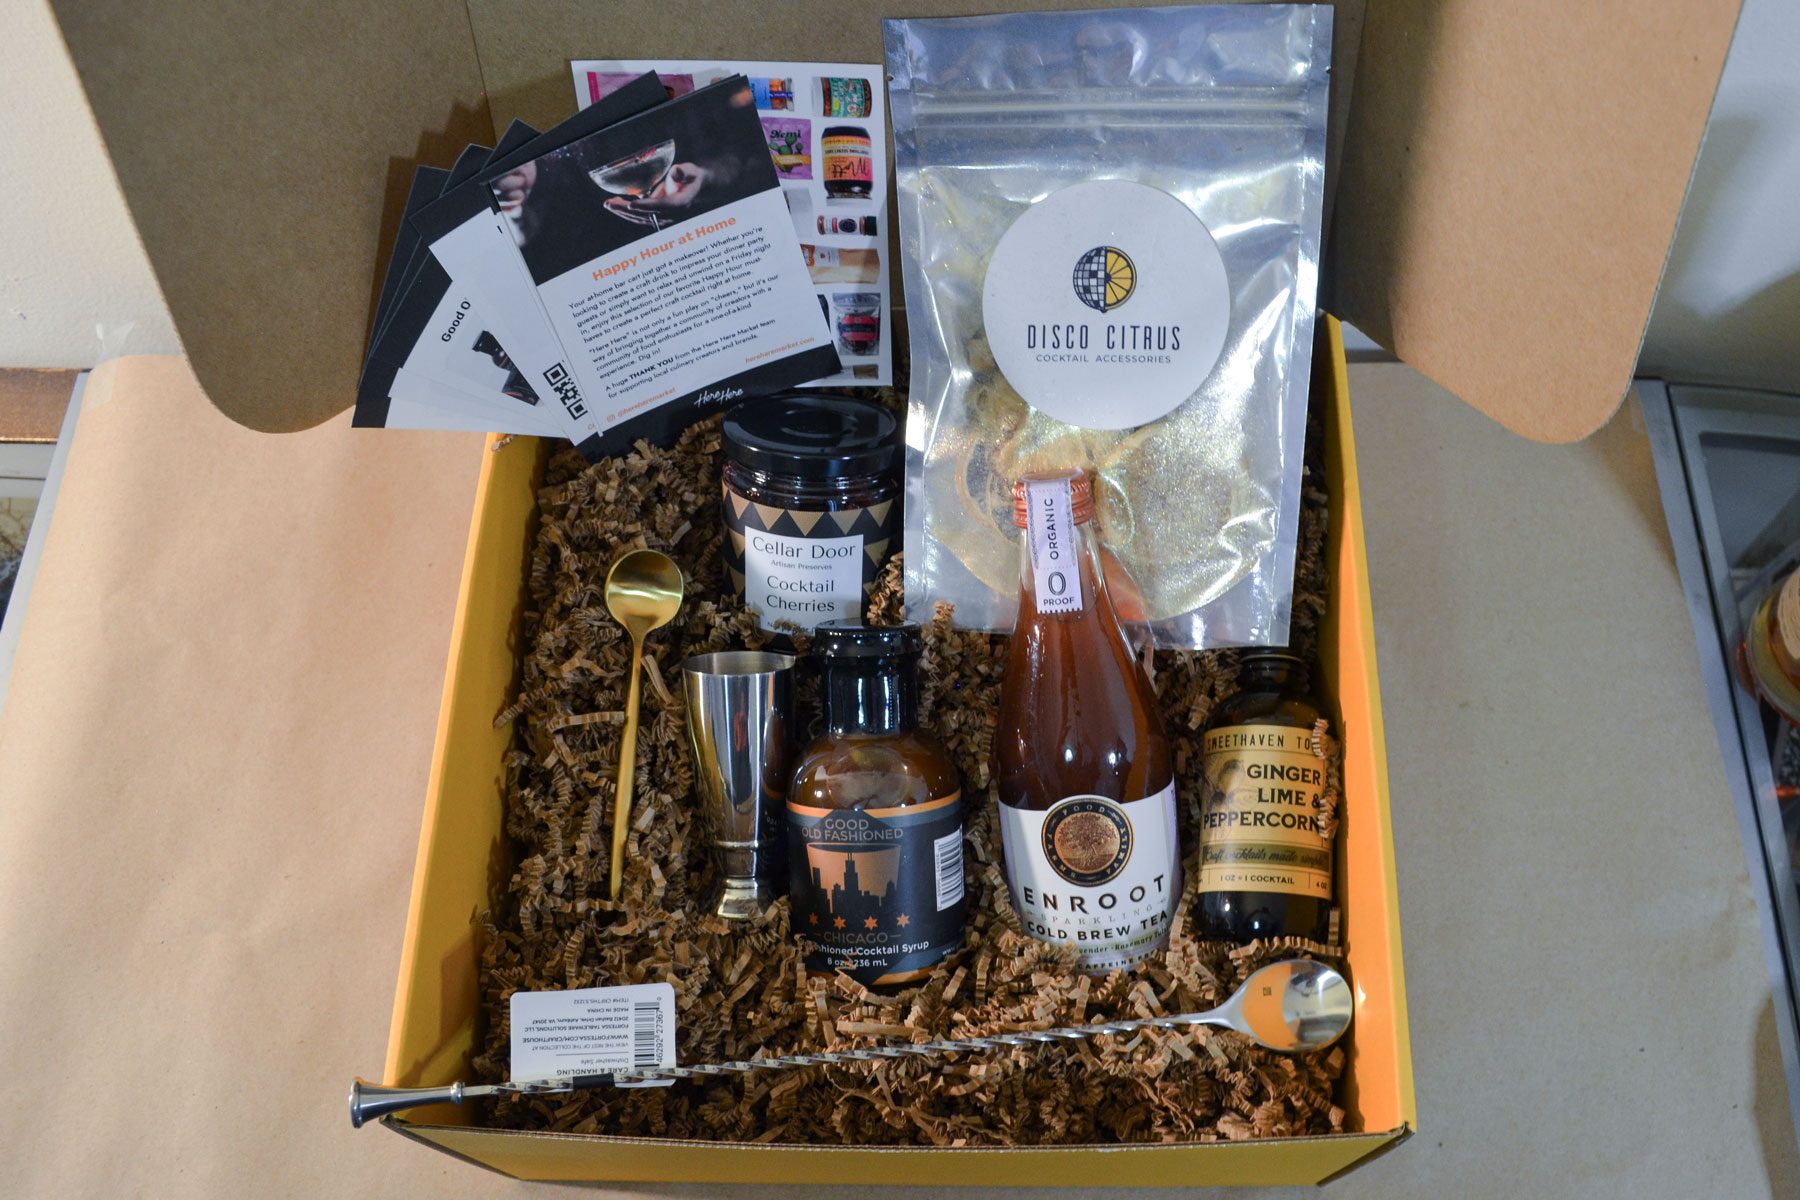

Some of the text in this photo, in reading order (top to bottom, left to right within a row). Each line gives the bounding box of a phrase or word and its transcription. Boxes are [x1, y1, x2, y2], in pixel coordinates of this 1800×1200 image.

[592, 217, 737, 282] Happy Hour at Home
[568, 299, 585, 309] Your
[627, 273, 641, 283] cart
[641, 267, 654, 279] just
[674, 245, 709, 263] makeover!
[709, 235, 739, 249] Whether
[572, 236, 764, 318] looking create craft drink impress your dinner party
[576, 314, 598, 328] guests
[608, 299, 630, 312] simply
[631, 291, 647, 302] want
[656, 281, 673, 291] relax
[688, 263, 714, 278] unwind
[731, 251, 752, 262] Friday
[754, 243, 771, 254] night
[591, 319, 609, 330] enjoy
[610, 313, 623, 321] this
[624, 300, 653, 315] selection
[675, 280, 701, 293] favorite
[701, 271, 724, 282] Happy
[725, 264, 743, 273] Hour
[583, 332, 603, 344] haves
[612, 318, 633, 330] create
[640, 304, 663, 319] perfect
[664, 297, 680, 308] craft
[681, 286, 706, 301] cocktail
[707, 280, 723, 291] right
[614, 337, 644, 353] bringing
[644, 325, 671, 340] together
[679, 308, 714, 325] community
[724, 294, 751, 307] creators
[751, 288, 766, 297] with
[651, 318, 665, 327] only
[685, 304, 699, 314] play
[441, 311, 465, 343] Good
[1027, 325, 1180, 350] DISCO CITRUS
[596, 352, 631, 371] community
[640, 339, 657, 351] food
[658, 326, 692, 344] enthusiasts
[611, 378, 629, 388] huge
[628, 364, 656, 380] THANK
[674, 351, 690, 360] from
[702, 340, 719, 349] Here
[719, 333, 736, 342] Here
[737, 324, 759, 336] Market
[759, 319, 776, 328] team
[1036, 355, 1171, 364] COCKTAIL ACCESSORIES
[619, 377, 653, 394] supporting
[653, 368, 669, 379] local
[669, 359, 694, 372] culinary
[695, 348, 721, 361] creators
[1044, 498, 1059, 560] ORGANIC
[752, 536, 856, 559] Cellar Door
[771, 559, 795, 569] Artisan
[767, 575, 834, 593] Cocktail
[766, 594, 835, 612] Cherries
[1043, 597, 1074, 606] PROOF
[1207, 733, 1285, 751] SWEETHAVEN
[1246, 764, 1321, 785] GINGER
[1257, 787, 1320, 808] LIME &
[1063, 804, 1105, 815] FOOD
[825, 818, 869, 830] GOOD
[1203, 811, 1320, 833] PEPPERCORN
[802, 827, 904, 841] OLD FASHIONED
[1224, 874, 1236, 882] OZ
[1250, 875, 1295, 884] COCKTAIL
[1023, 874, 1165, 915] ENROOT
[1027, 910, 1168, 941] COLD BREW TEA
[824, 932, 888, 944] CHICAGO
[856, 945, 899, 956] Cocktail
[902, 941, 929, 954] Syrup
[1114, 936, 1153, 951] Rosemary
[827, 957, 832, 965] 8
[854, 959, 870, 967] 236
[872, 958, 888, 967] mL
[1078, 958, 1134, 970] CAFFEINE
[523, 1035, 628, 1043] WWW.FORTESSA.COM/CRAFTHOUSE
